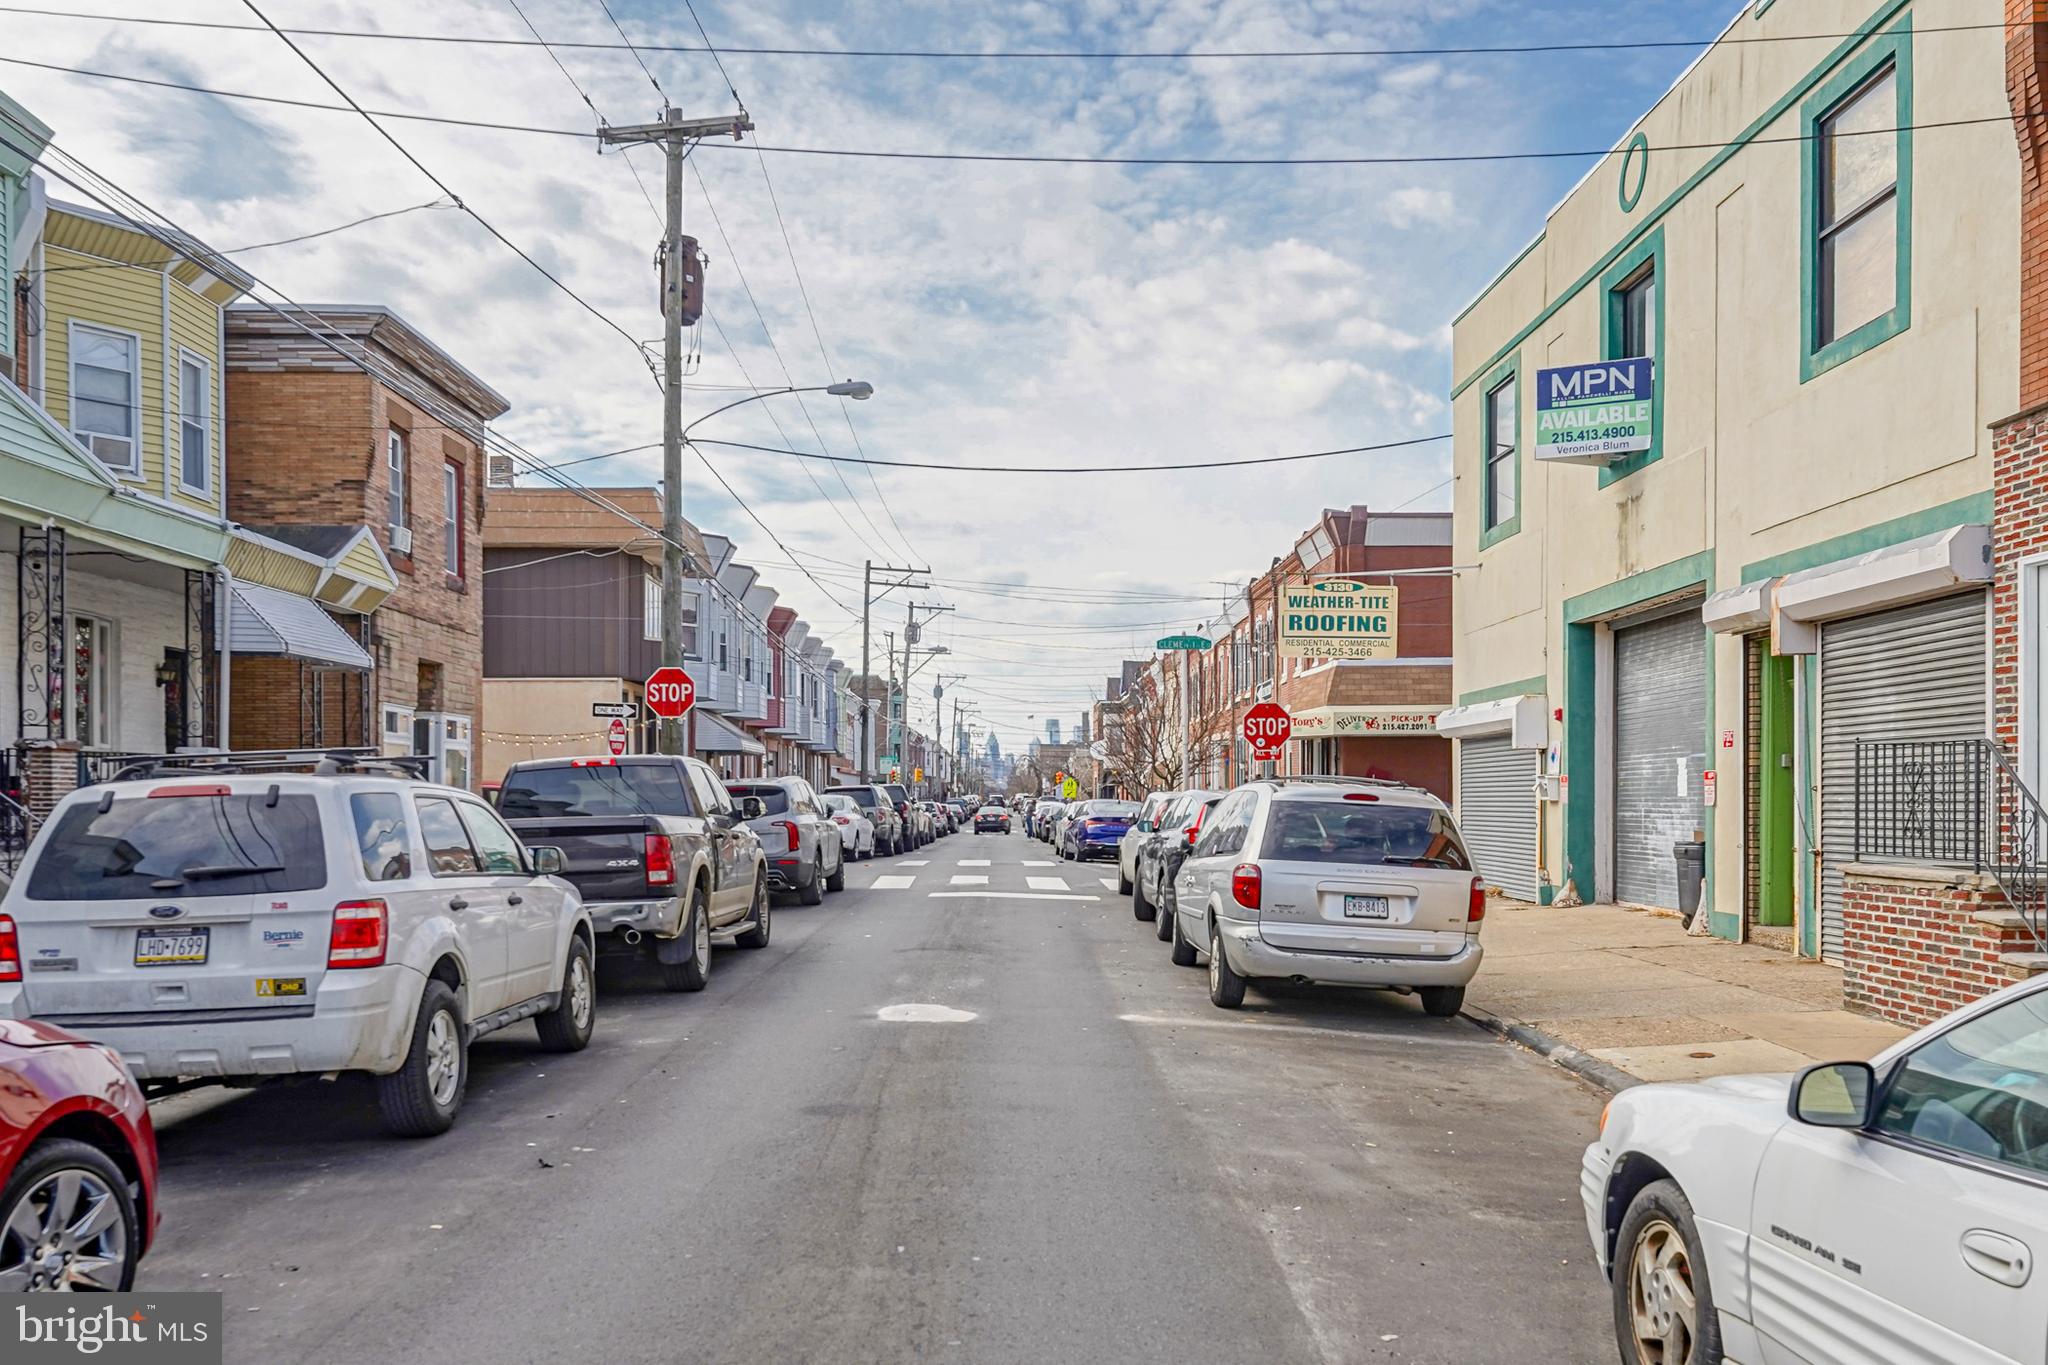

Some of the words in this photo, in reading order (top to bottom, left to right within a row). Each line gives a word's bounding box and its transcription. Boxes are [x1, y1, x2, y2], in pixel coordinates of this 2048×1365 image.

[1552, 365, 1635, 397] MPN
[1540, 403, 1649, 431] AVAILABLE
[1552, 426, 1635, 444] 215.413.4900
[1556, 442, 1600, 454] Veronica
[1603, 440, 1630, 450] Blum
[1324, 583, 1354, 592] 3130
[1288, 595, 1389, 609] WEATHER-TITE
[1288, 614, 1387, 633] ROOFING
[1338, 640, 1390, 648] COMMERCIAL
[1303, 647, 1373, 657] 215-425-3466
[648, 683, 692, 702] STOP
[596, 706, 608, 714] ONE
[1290, 716, 1324, 728] Tony's
[1336, 715, 1372, 730] DELIVER
[1391, 715, 1424, 723] PICK-UP
[1246, 717, 1288, 736] STOP
[263, 930, 304, 941] Bernie
